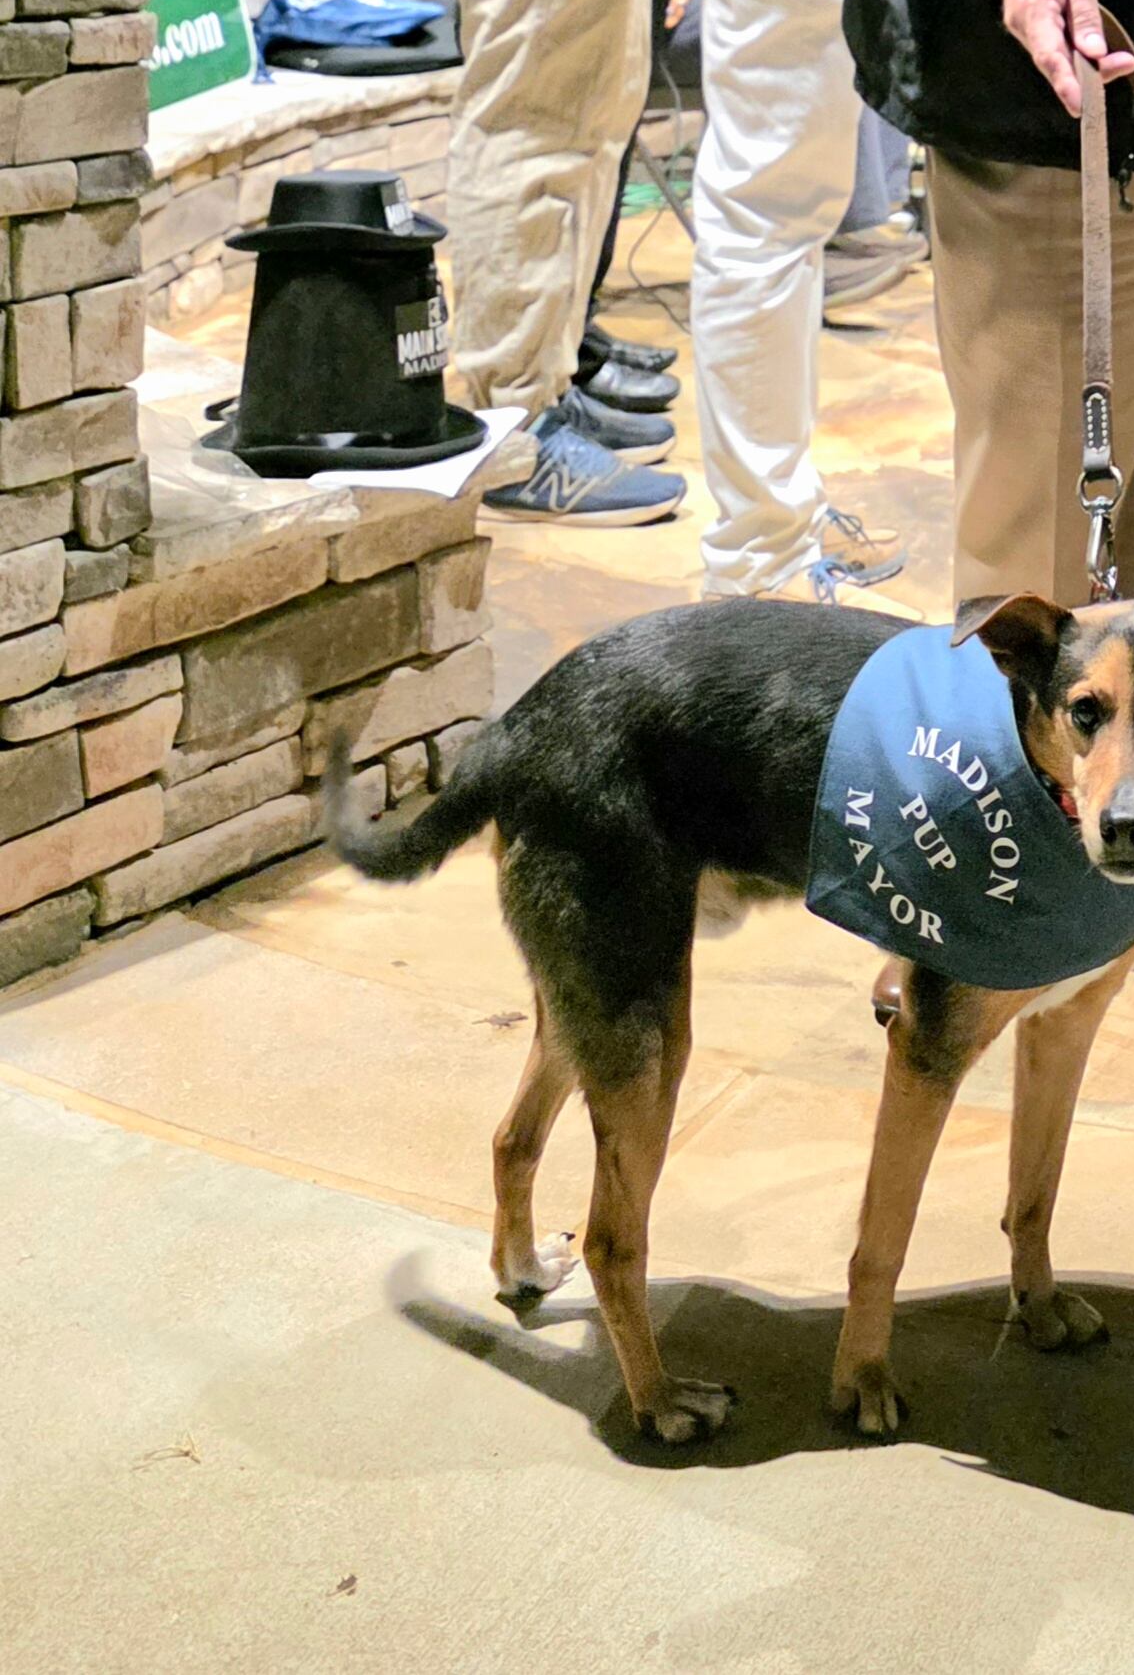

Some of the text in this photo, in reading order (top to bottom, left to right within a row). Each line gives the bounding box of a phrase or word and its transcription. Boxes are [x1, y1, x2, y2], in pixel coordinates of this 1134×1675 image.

[844, 787, 944, 944] MAYOR
[900, 793, 957, 870] PUP
[907, 726, 1021, 905] MADISON
